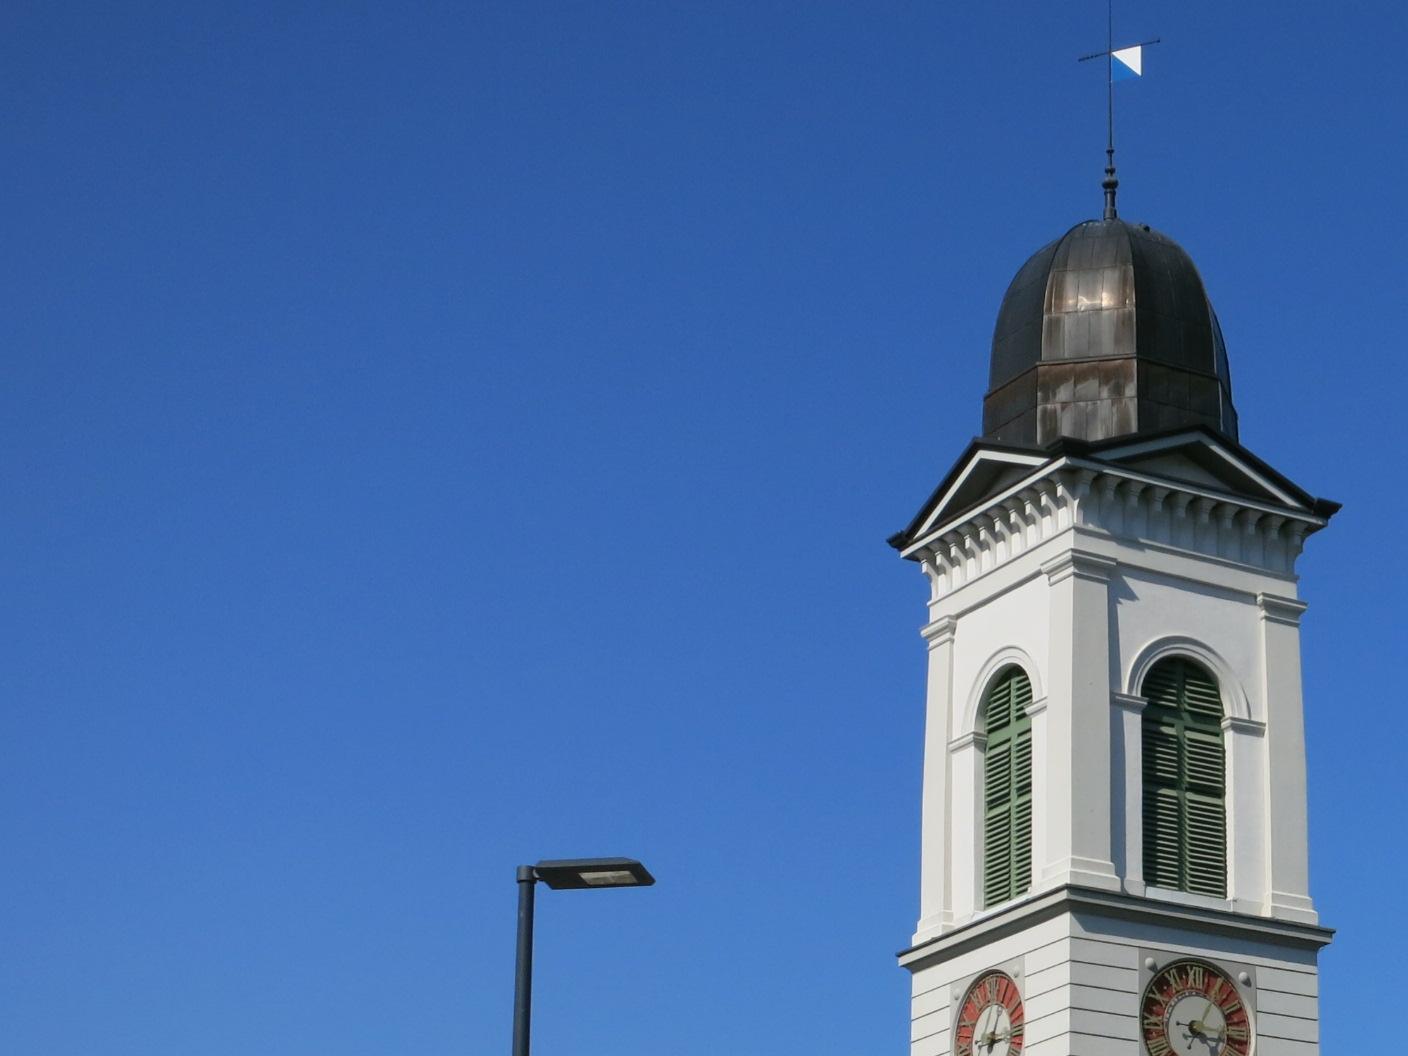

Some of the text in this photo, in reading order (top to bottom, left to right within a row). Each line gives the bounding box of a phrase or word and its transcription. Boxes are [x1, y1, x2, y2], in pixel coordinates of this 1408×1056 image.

[1164, 968, 1184, 994] XI
[1187, 965, 1203, 990] XII
[1148, 986, 1168, 1007] X
[1143, 1012, 1164, 1029] IX
